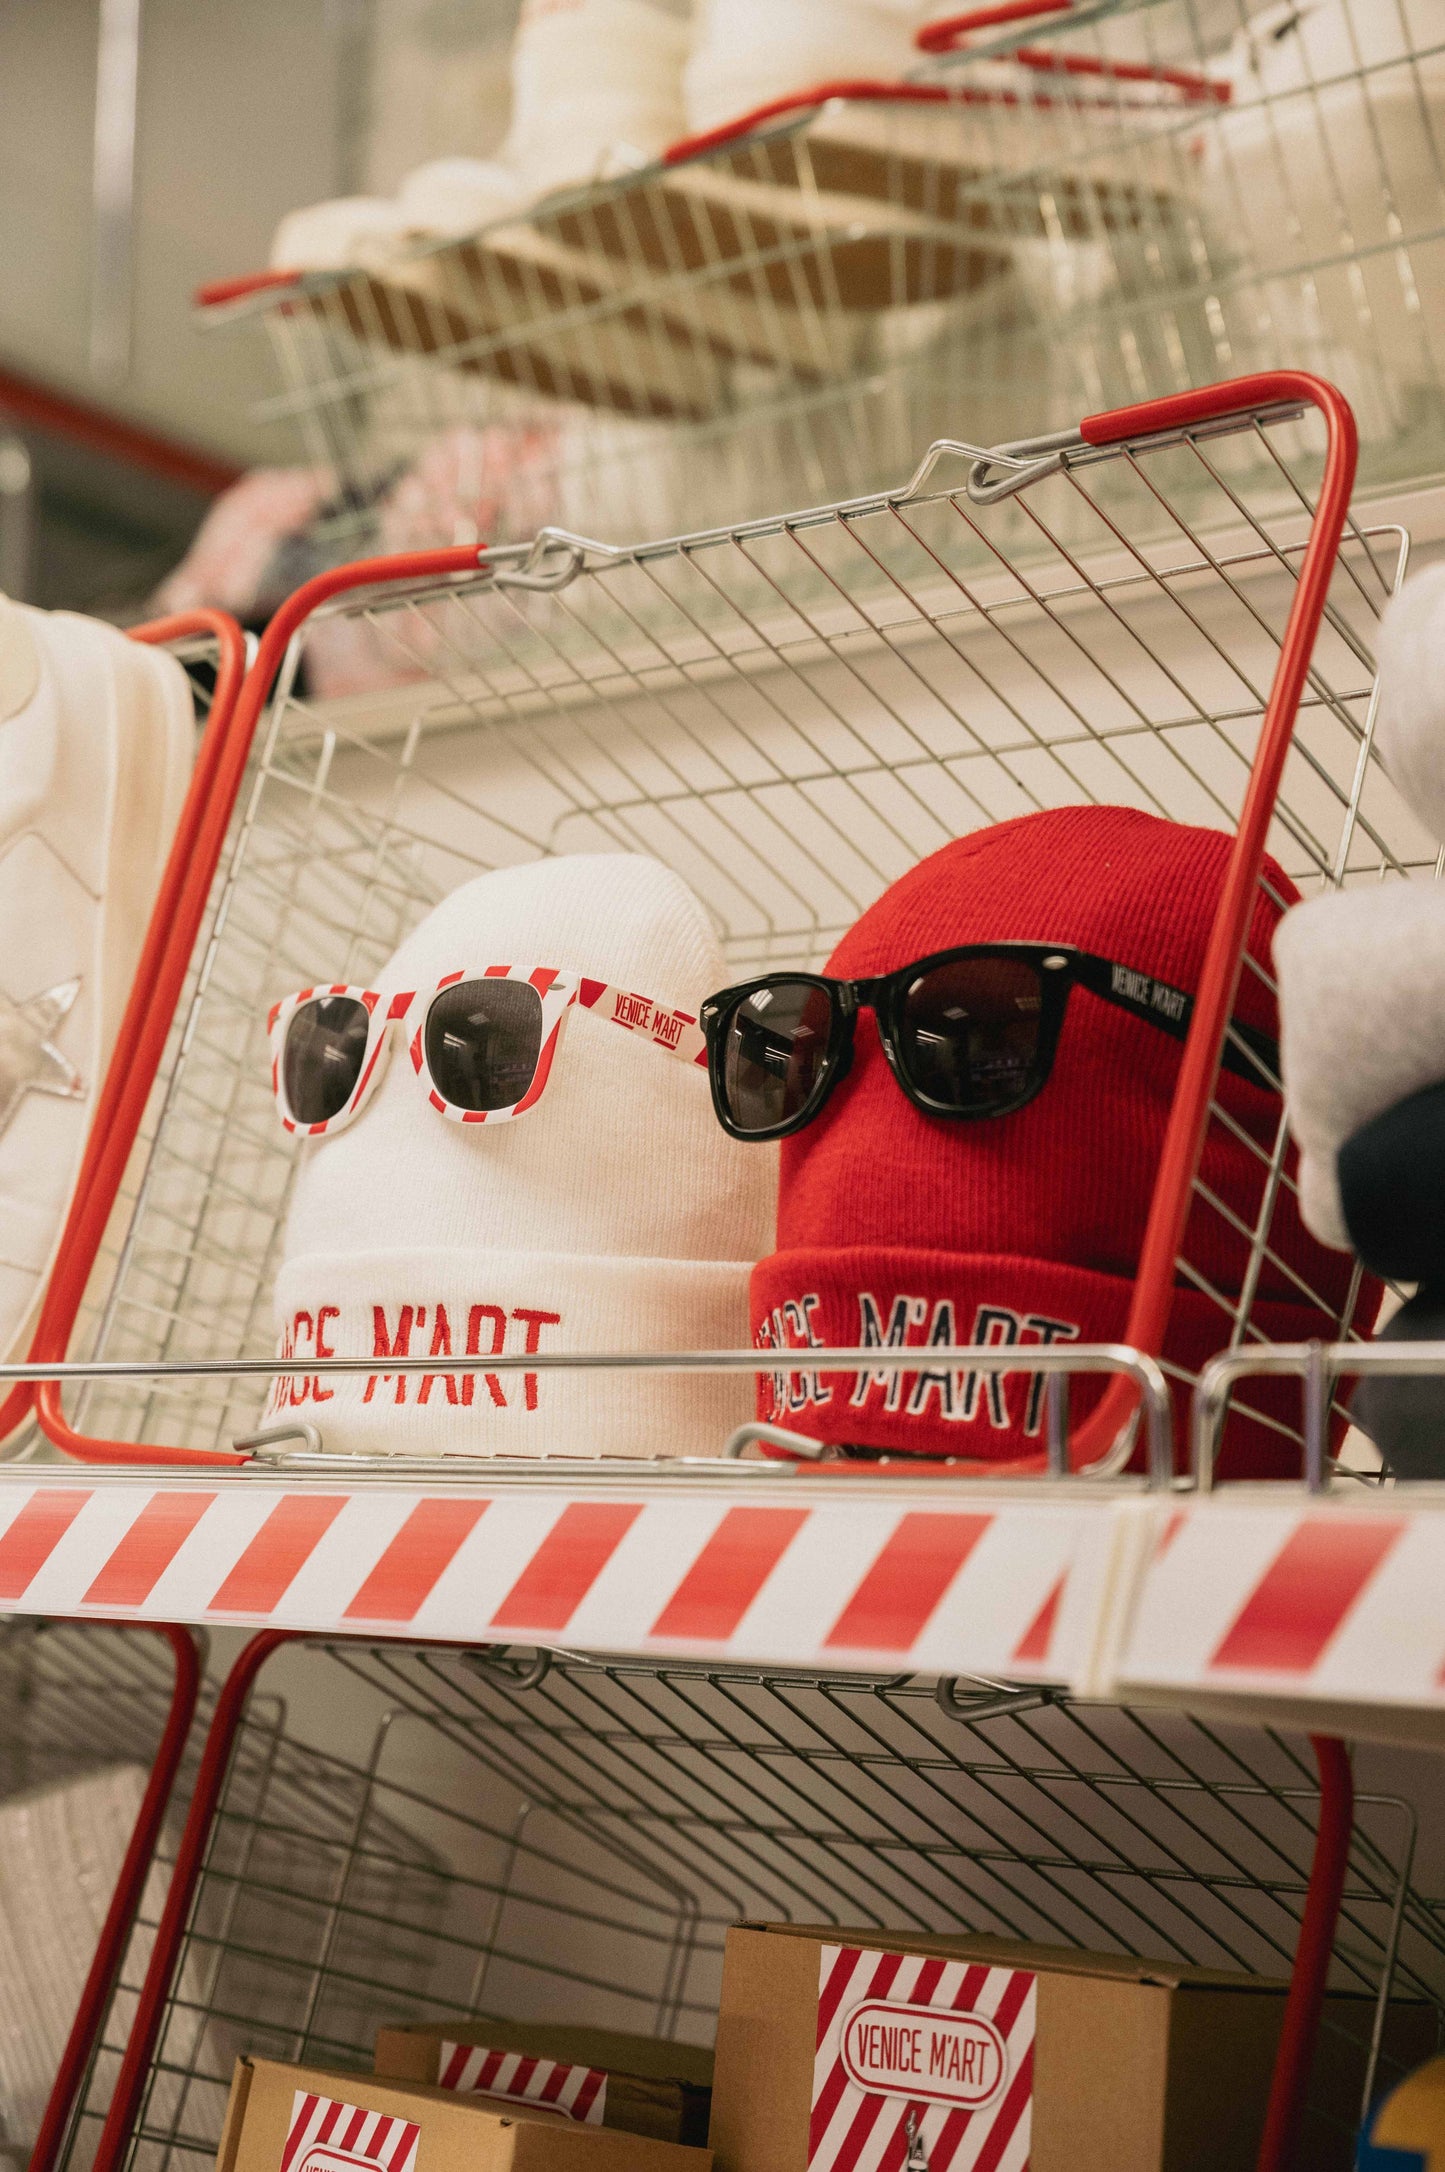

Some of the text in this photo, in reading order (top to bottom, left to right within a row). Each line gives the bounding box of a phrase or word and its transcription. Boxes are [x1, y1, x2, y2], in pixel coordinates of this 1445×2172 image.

[1112, 963, 1150, 1005] VENICE
[615, 993, 685, 1044] VENICE M'ART
[362, 1303, 561, 1411] M'ART
[858, 2023, 990, 2085] VENICE M'ART
